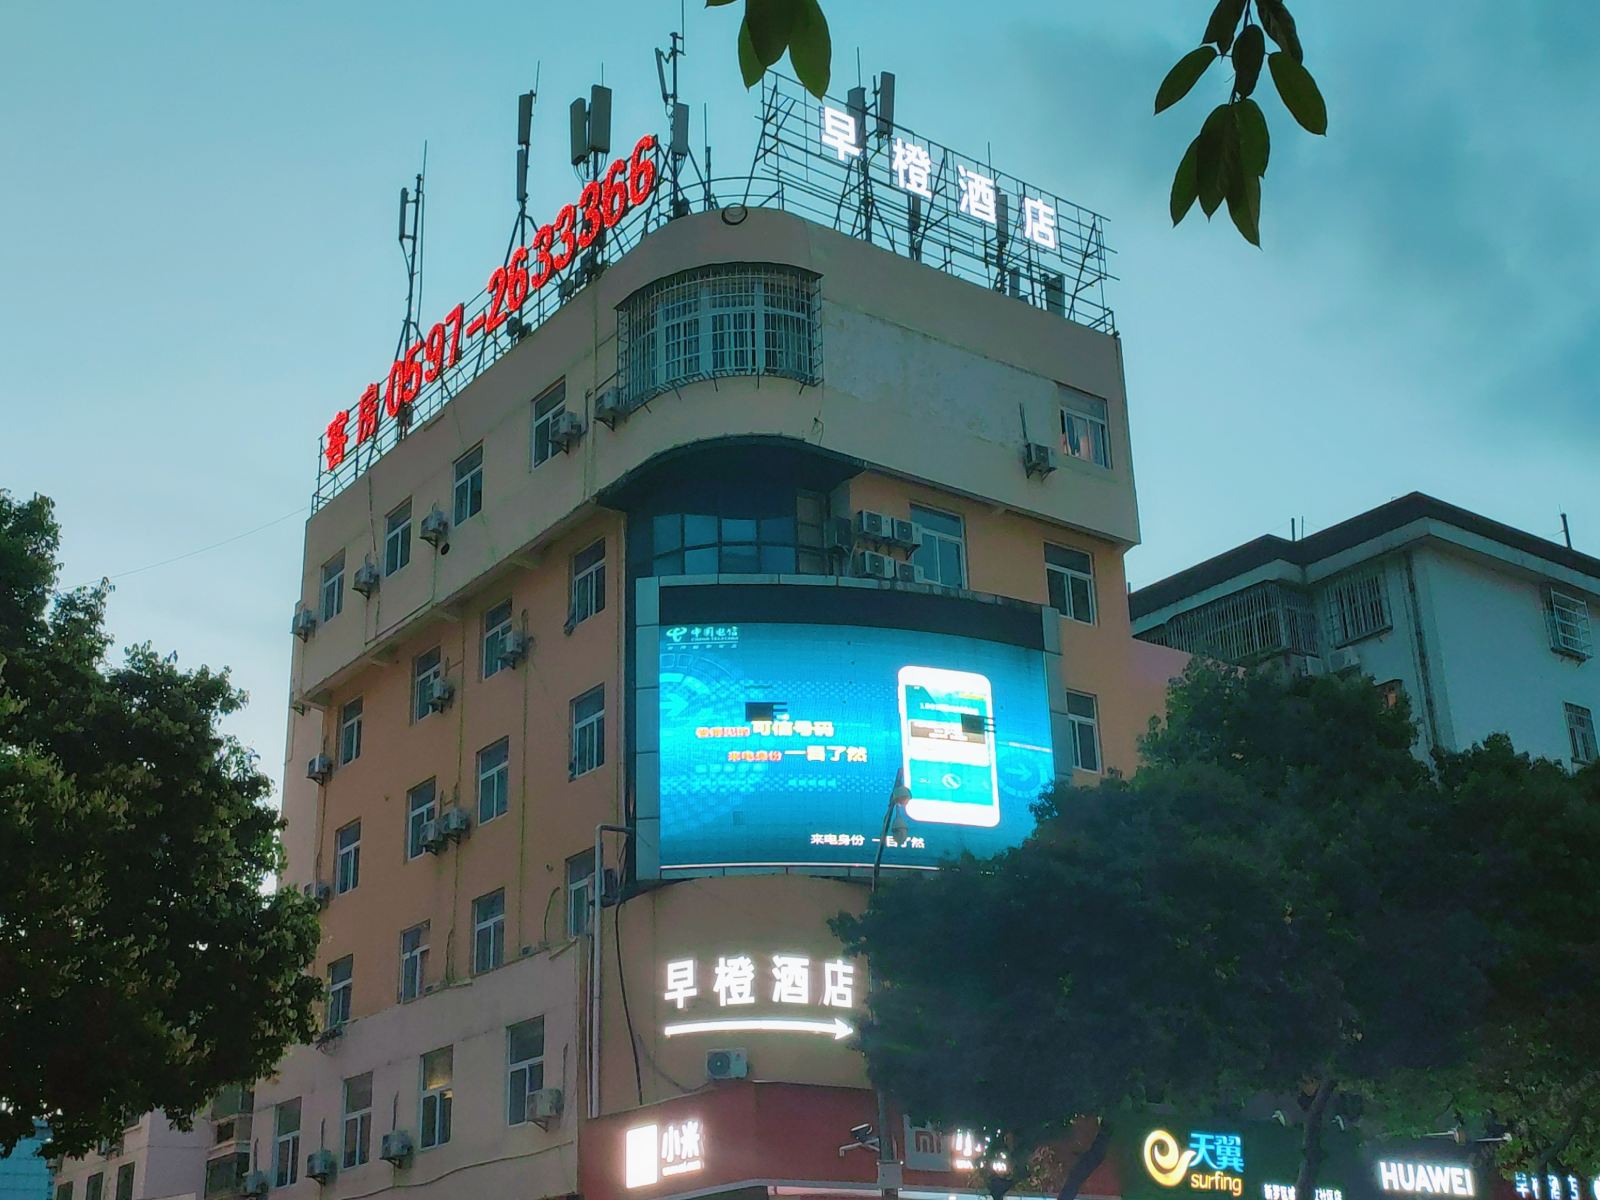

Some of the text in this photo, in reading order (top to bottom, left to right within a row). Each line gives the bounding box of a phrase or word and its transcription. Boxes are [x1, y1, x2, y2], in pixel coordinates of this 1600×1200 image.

[821, 106, 1057, 250] 早橙酒店
[691, 626, 738, 637] 中国电信
[664, 955, 854, 1009] 早橙酒店
[661, 1120, 700, 1163] 小米
[1189, 1132, 1244, 1173] 天翼
[1190, 1171, 1243, 1196] surfing
[1379, 1161, 1475, 1196] HUAWEI
